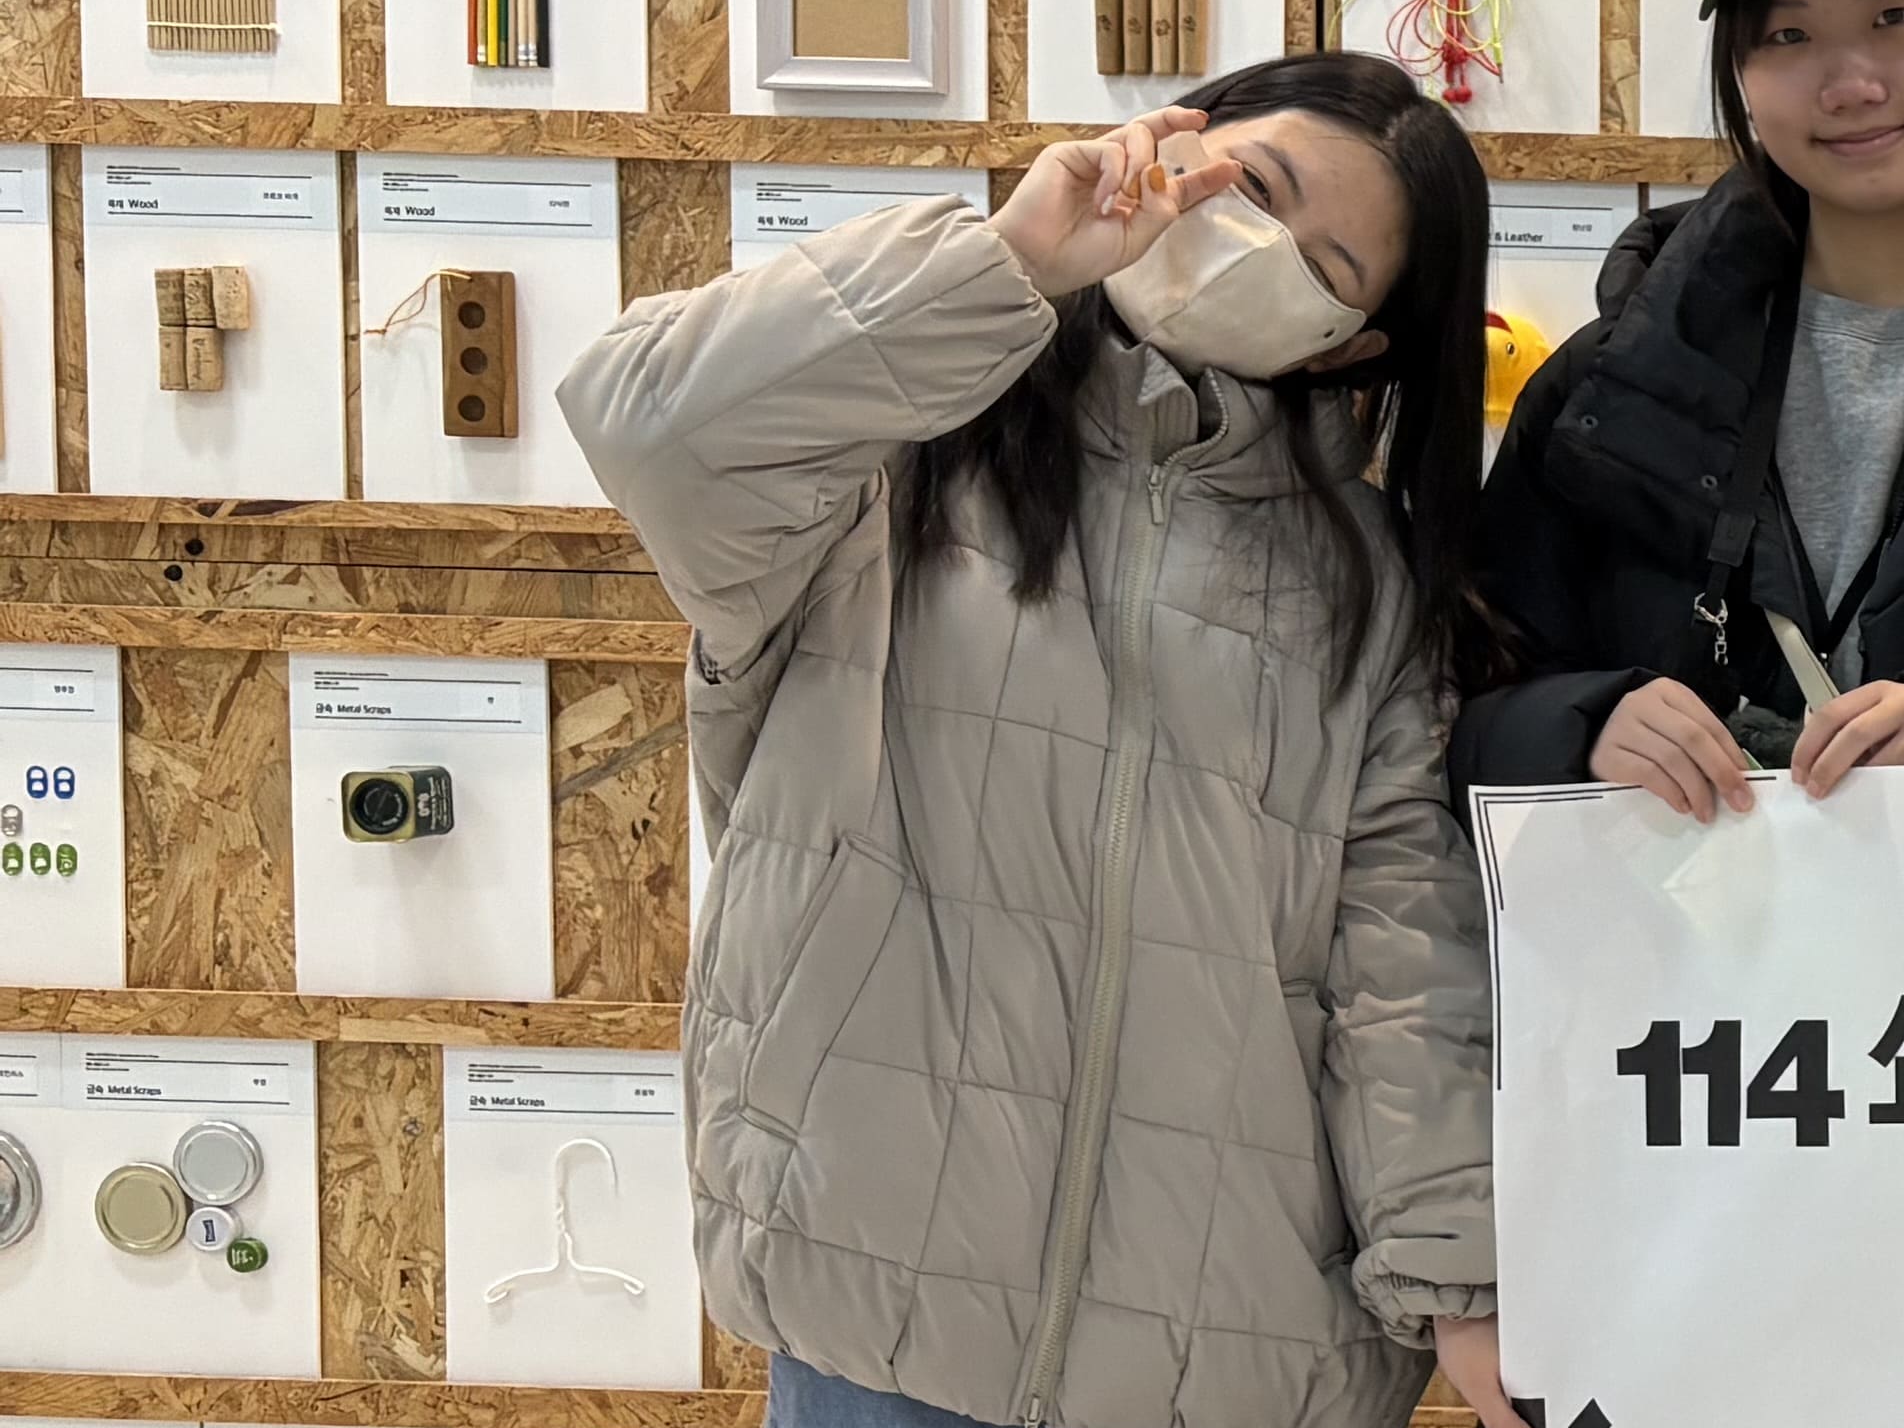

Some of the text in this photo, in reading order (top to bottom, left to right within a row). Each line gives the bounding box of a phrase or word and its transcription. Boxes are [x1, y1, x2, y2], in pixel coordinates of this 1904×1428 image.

[128, 200, 158, 209] Wood
[405, 206, 435, 216] Wood
[778, 216, 808, 225] Wood
[1505, 232, 1543, 242] Leather
[1617, 1020, 1845, 1147] 114
